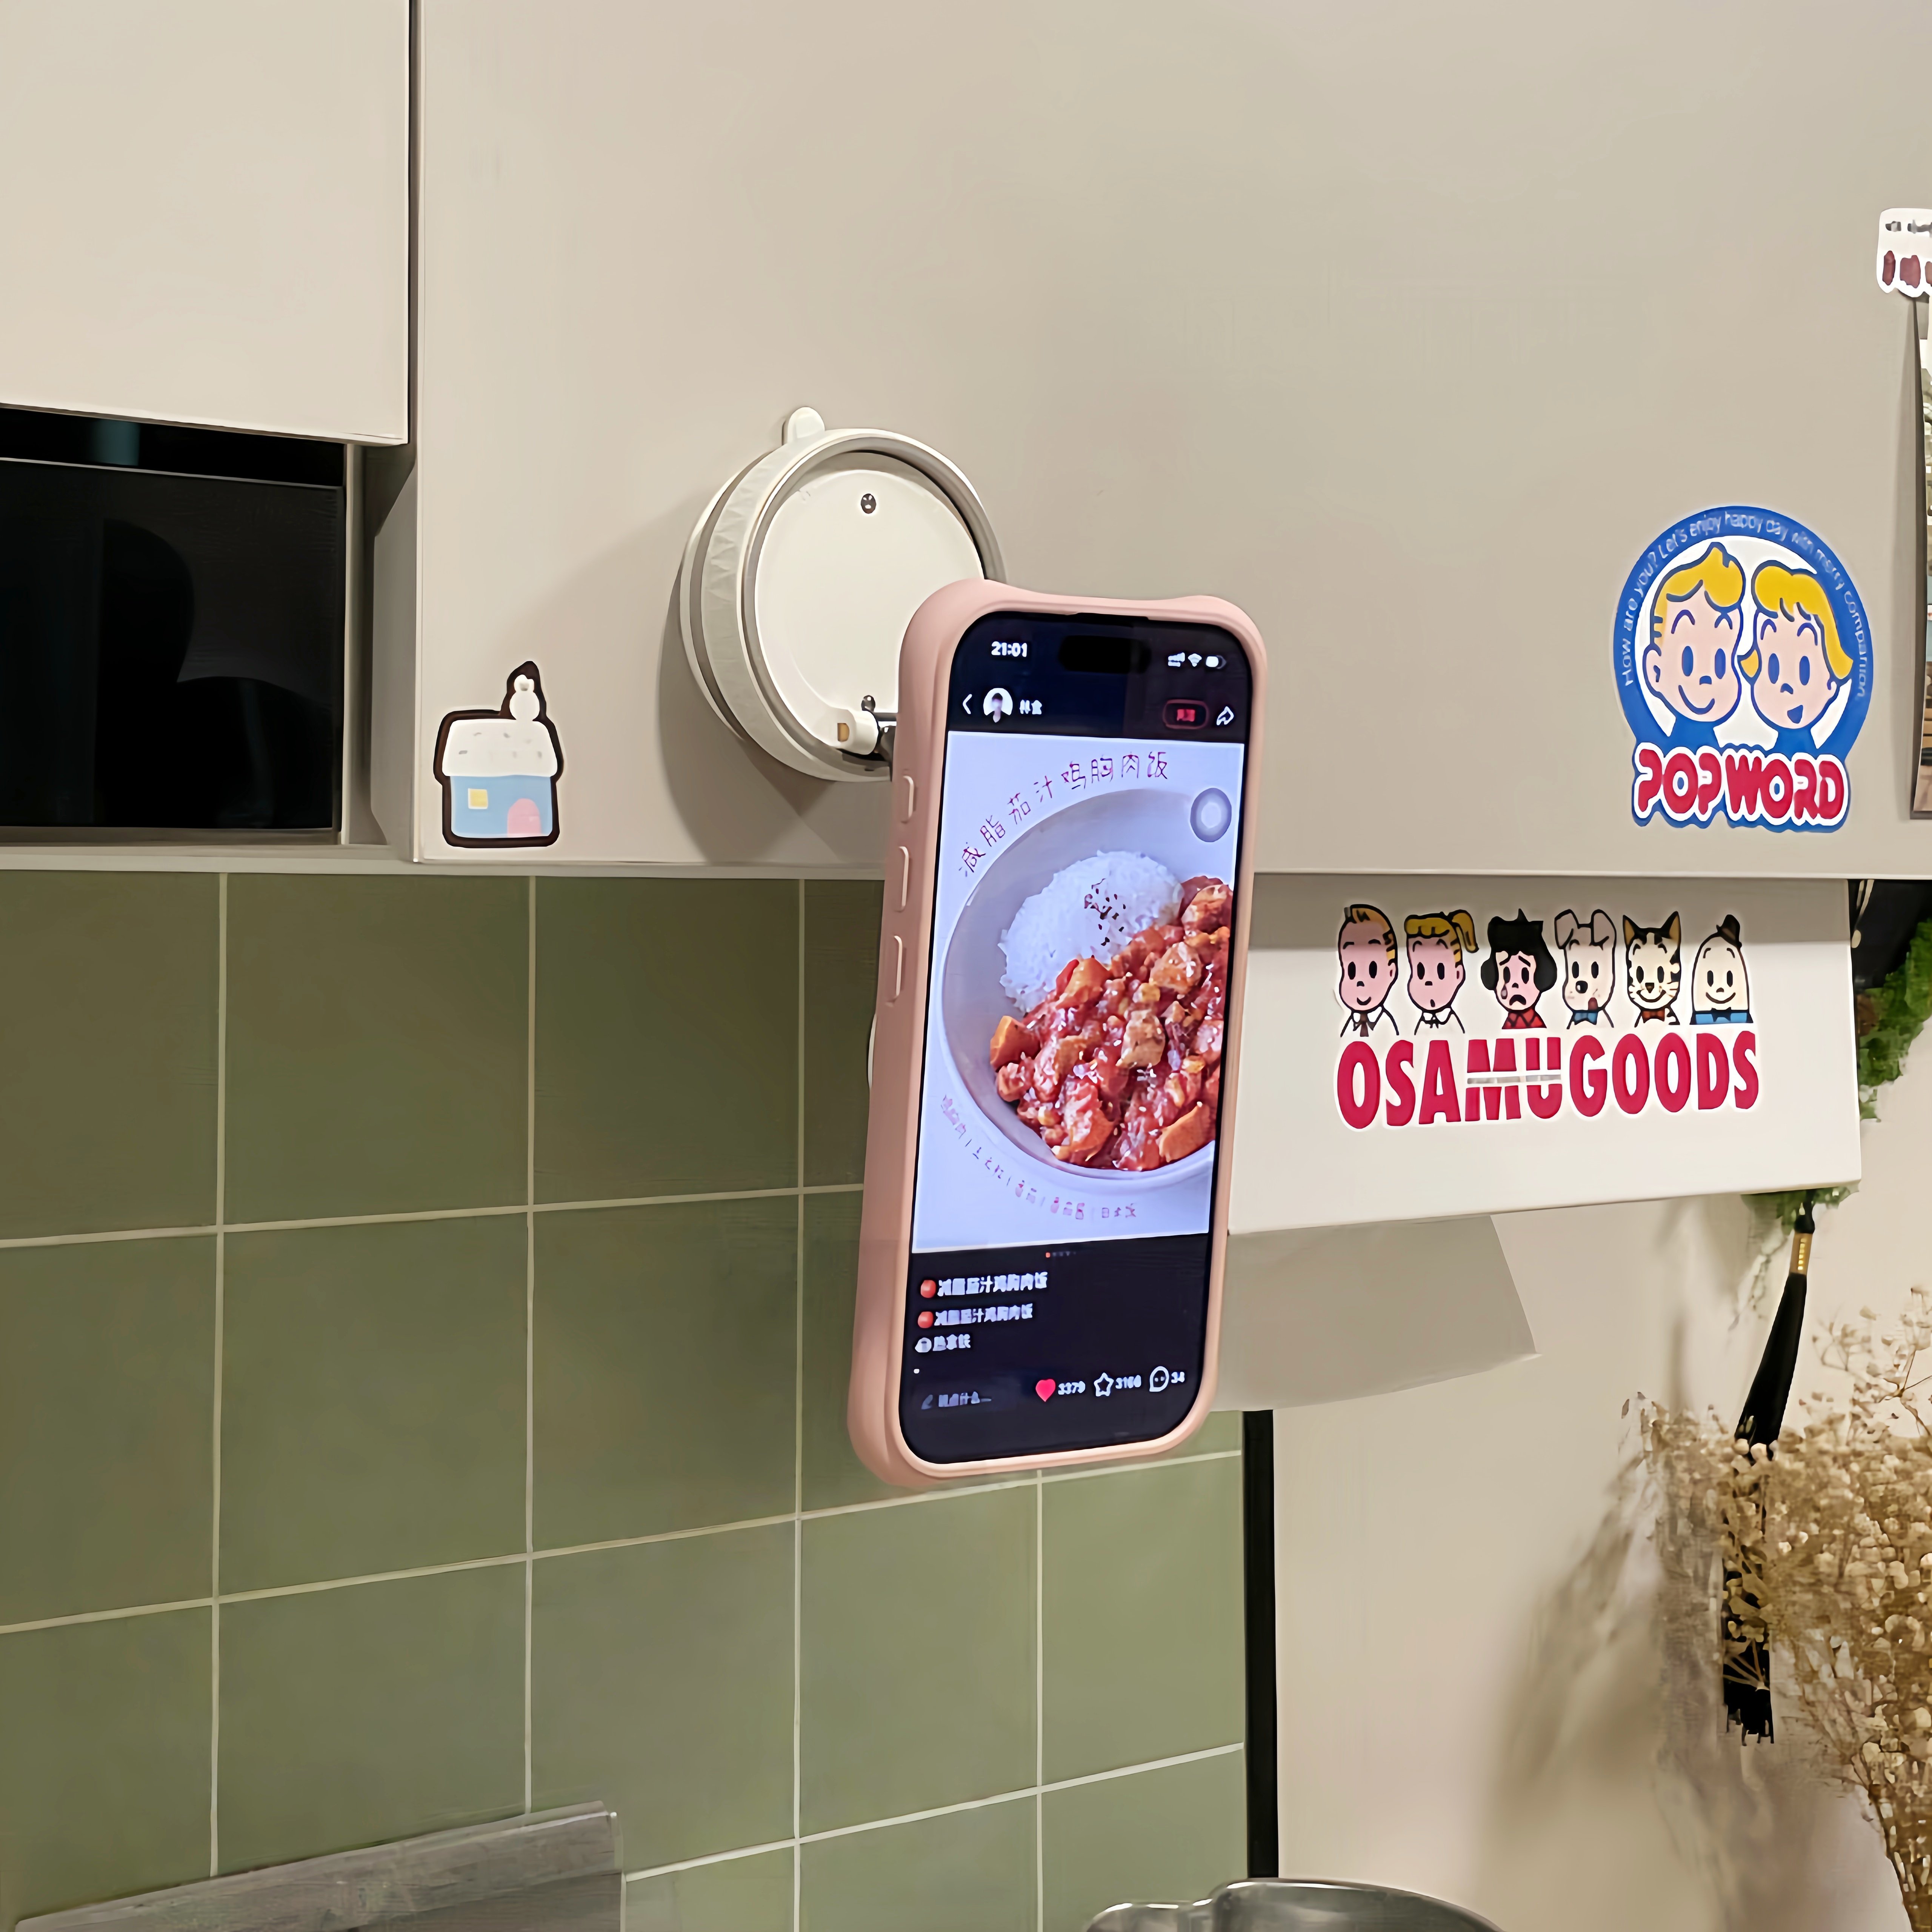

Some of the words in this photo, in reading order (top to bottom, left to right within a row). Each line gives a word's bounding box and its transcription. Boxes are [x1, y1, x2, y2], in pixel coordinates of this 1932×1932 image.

[1658, 529, 1688, 559] Let's
[1634, 551, 1658, 598] you?
[1623, 598, 1638, 631] are
[991, 641, 1028, 657] 21:01
[1622, 638, 1634, 686] How
[958, 751, 1168, 878] 减脂茄汁鸡胸肉饭
